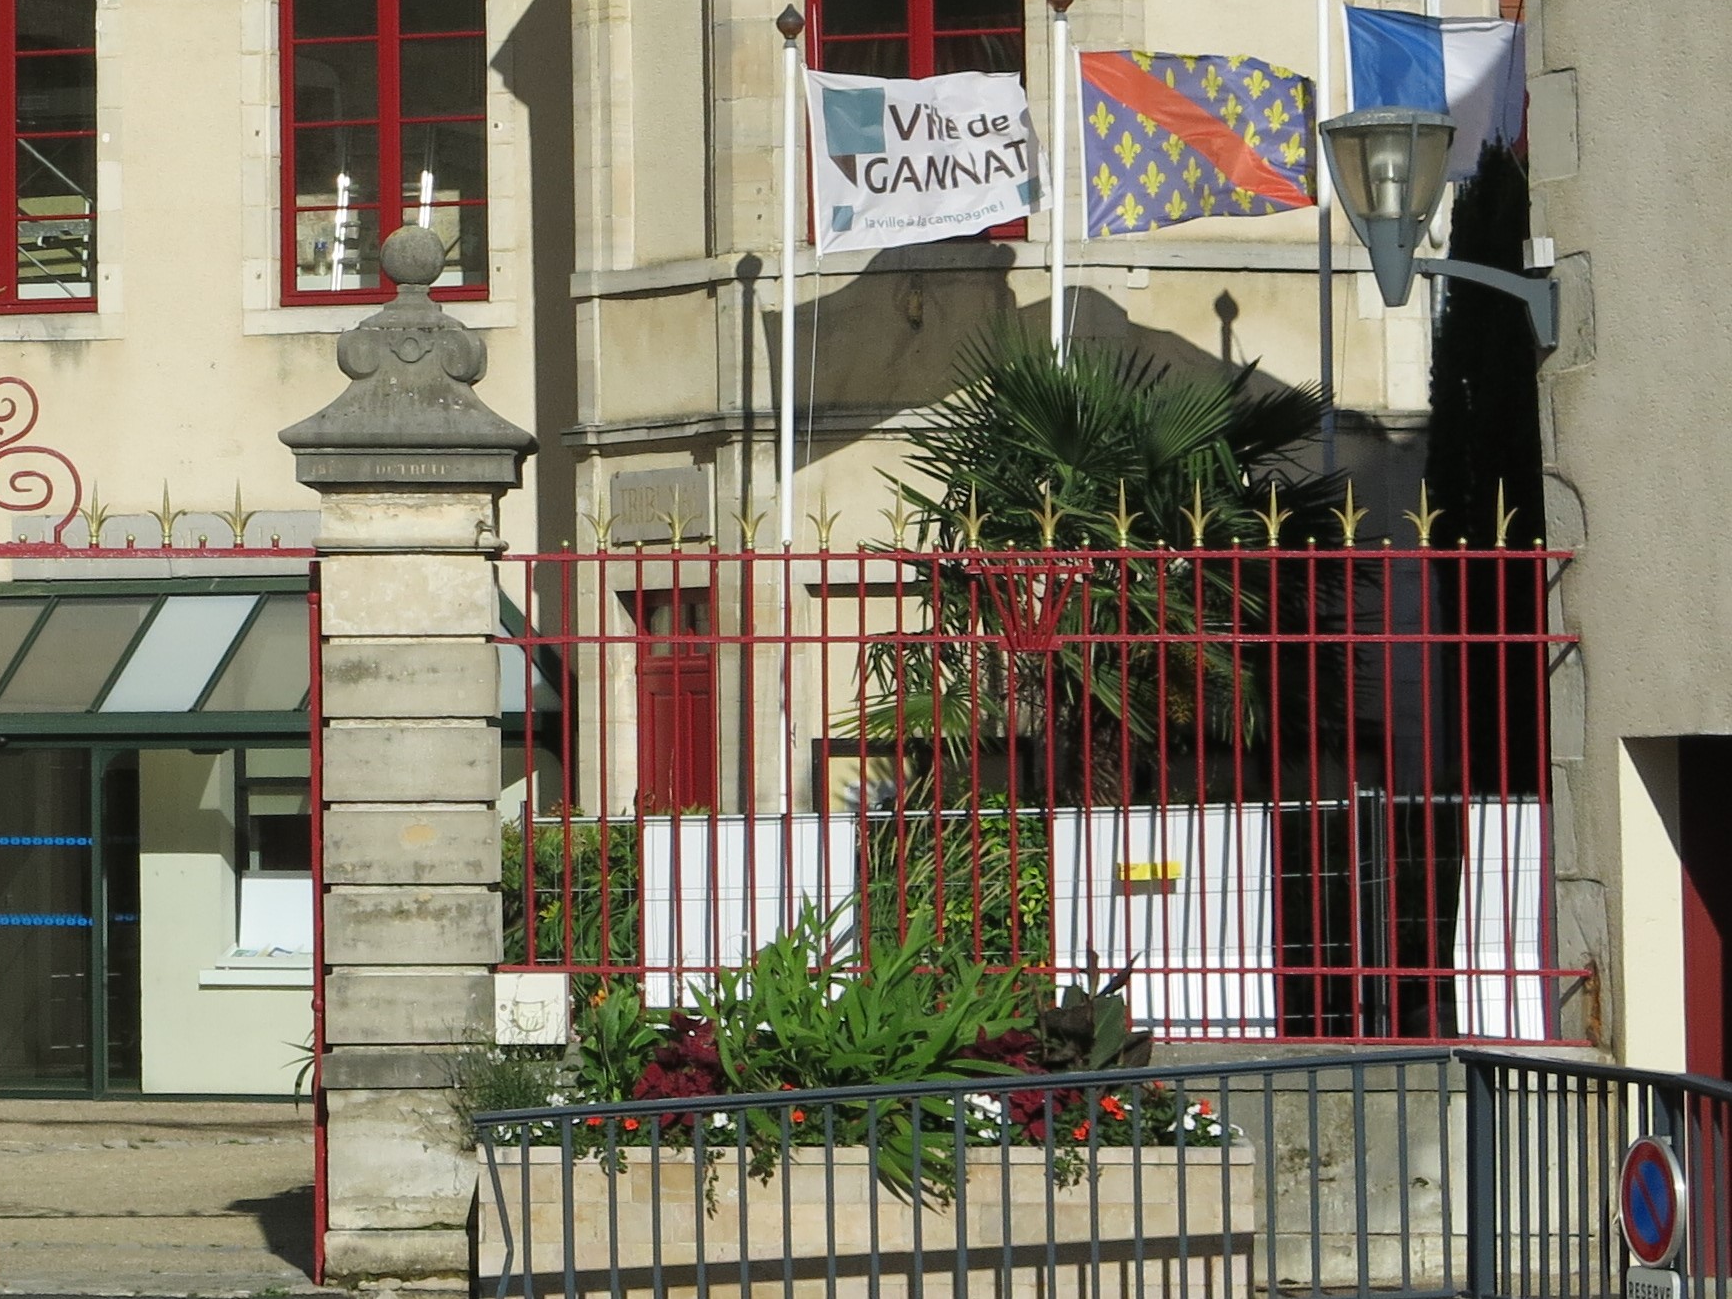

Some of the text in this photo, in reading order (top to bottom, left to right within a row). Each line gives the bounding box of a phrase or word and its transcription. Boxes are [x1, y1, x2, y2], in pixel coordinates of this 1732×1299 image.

[968, 113, 1010, 138] de
[864, 139, 1028, 194] GANNAT
[865, 217, 875, 228] la
[878, 216, 905, 228] ville
